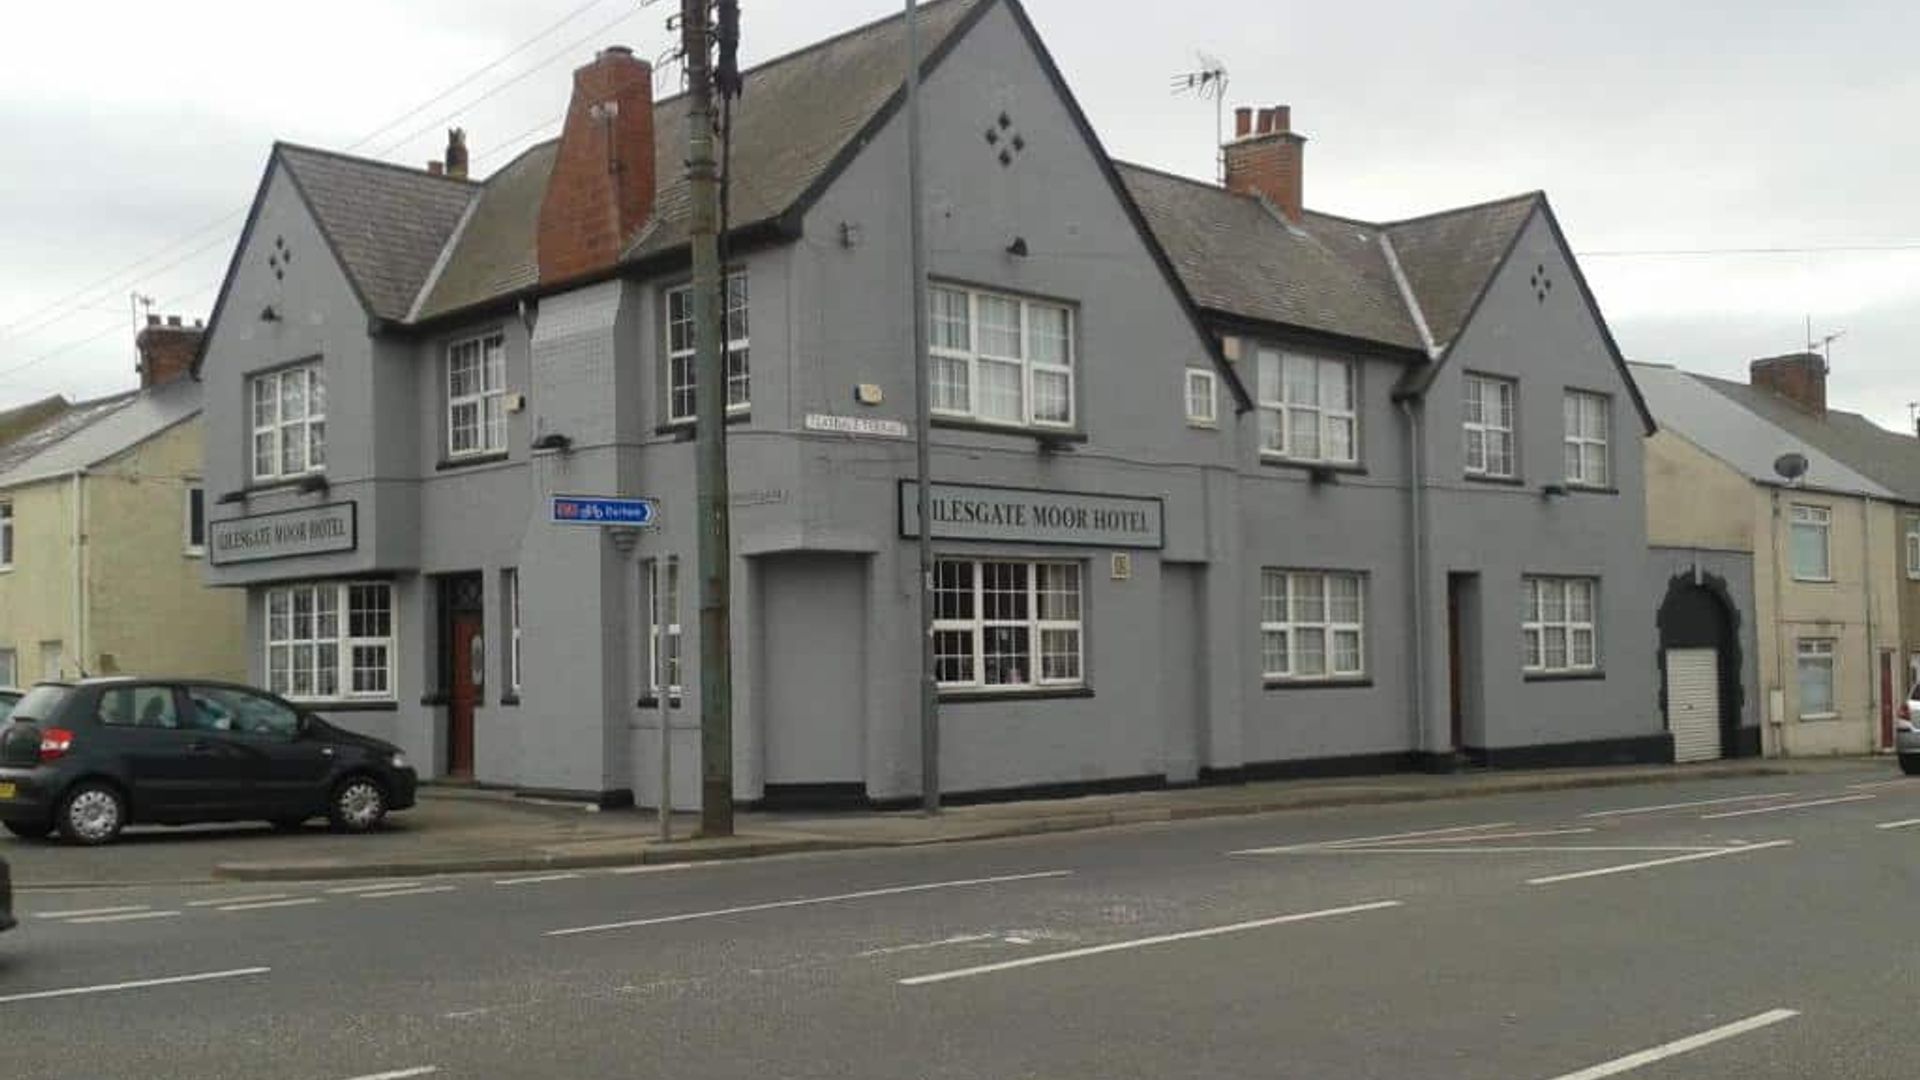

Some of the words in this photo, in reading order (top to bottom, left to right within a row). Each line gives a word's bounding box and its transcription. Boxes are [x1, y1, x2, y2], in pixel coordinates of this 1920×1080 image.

[917, 498, 1027, 526] ILESGATE
[1032, 504, 1087, 529] MOOR
[1094, 510, 1149, 533] HOTEL
